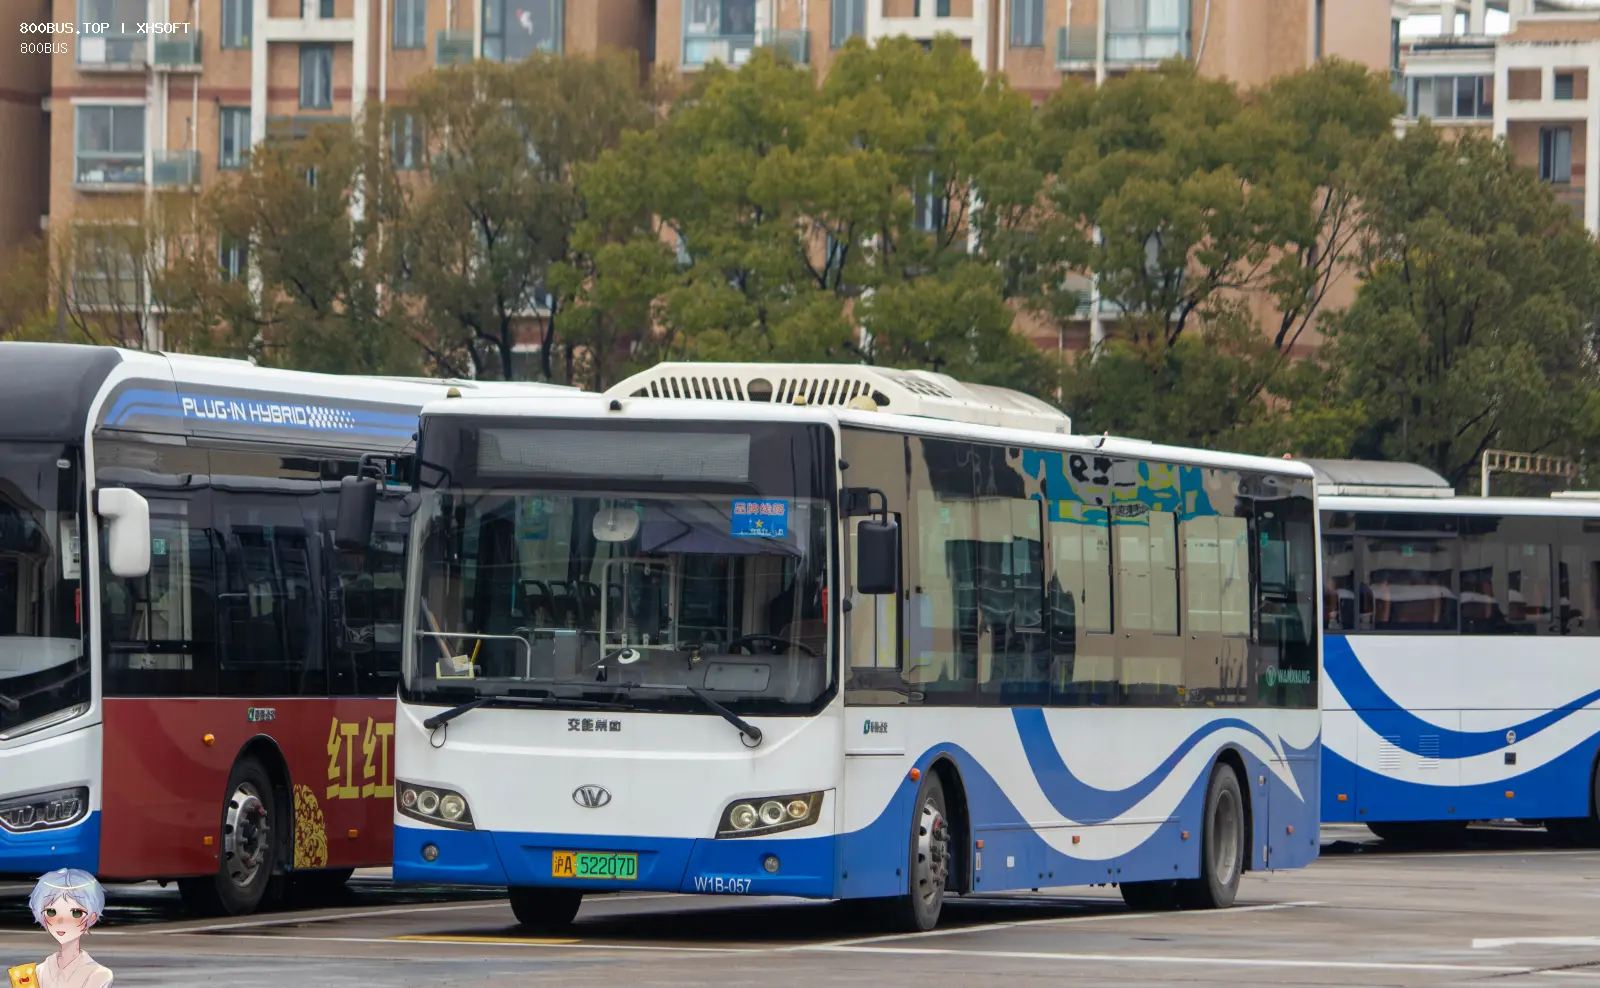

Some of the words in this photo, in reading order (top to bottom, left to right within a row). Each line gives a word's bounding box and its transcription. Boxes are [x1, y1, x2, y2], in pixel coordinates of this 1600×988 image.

[181, 397, 247, 421] PLUG-IN
[249, 402, 307, 425] HYBRID
[733, 502, 786, 516] 品牌线路
[1278, 669, 1310, 684] WANXIANG
[327, 716, 394, 799] 红红
[554, 855, 573, 874] 沪A
[580, 856, 635, 876] 52207D
[694, 876, 752, 893] W1B-057
